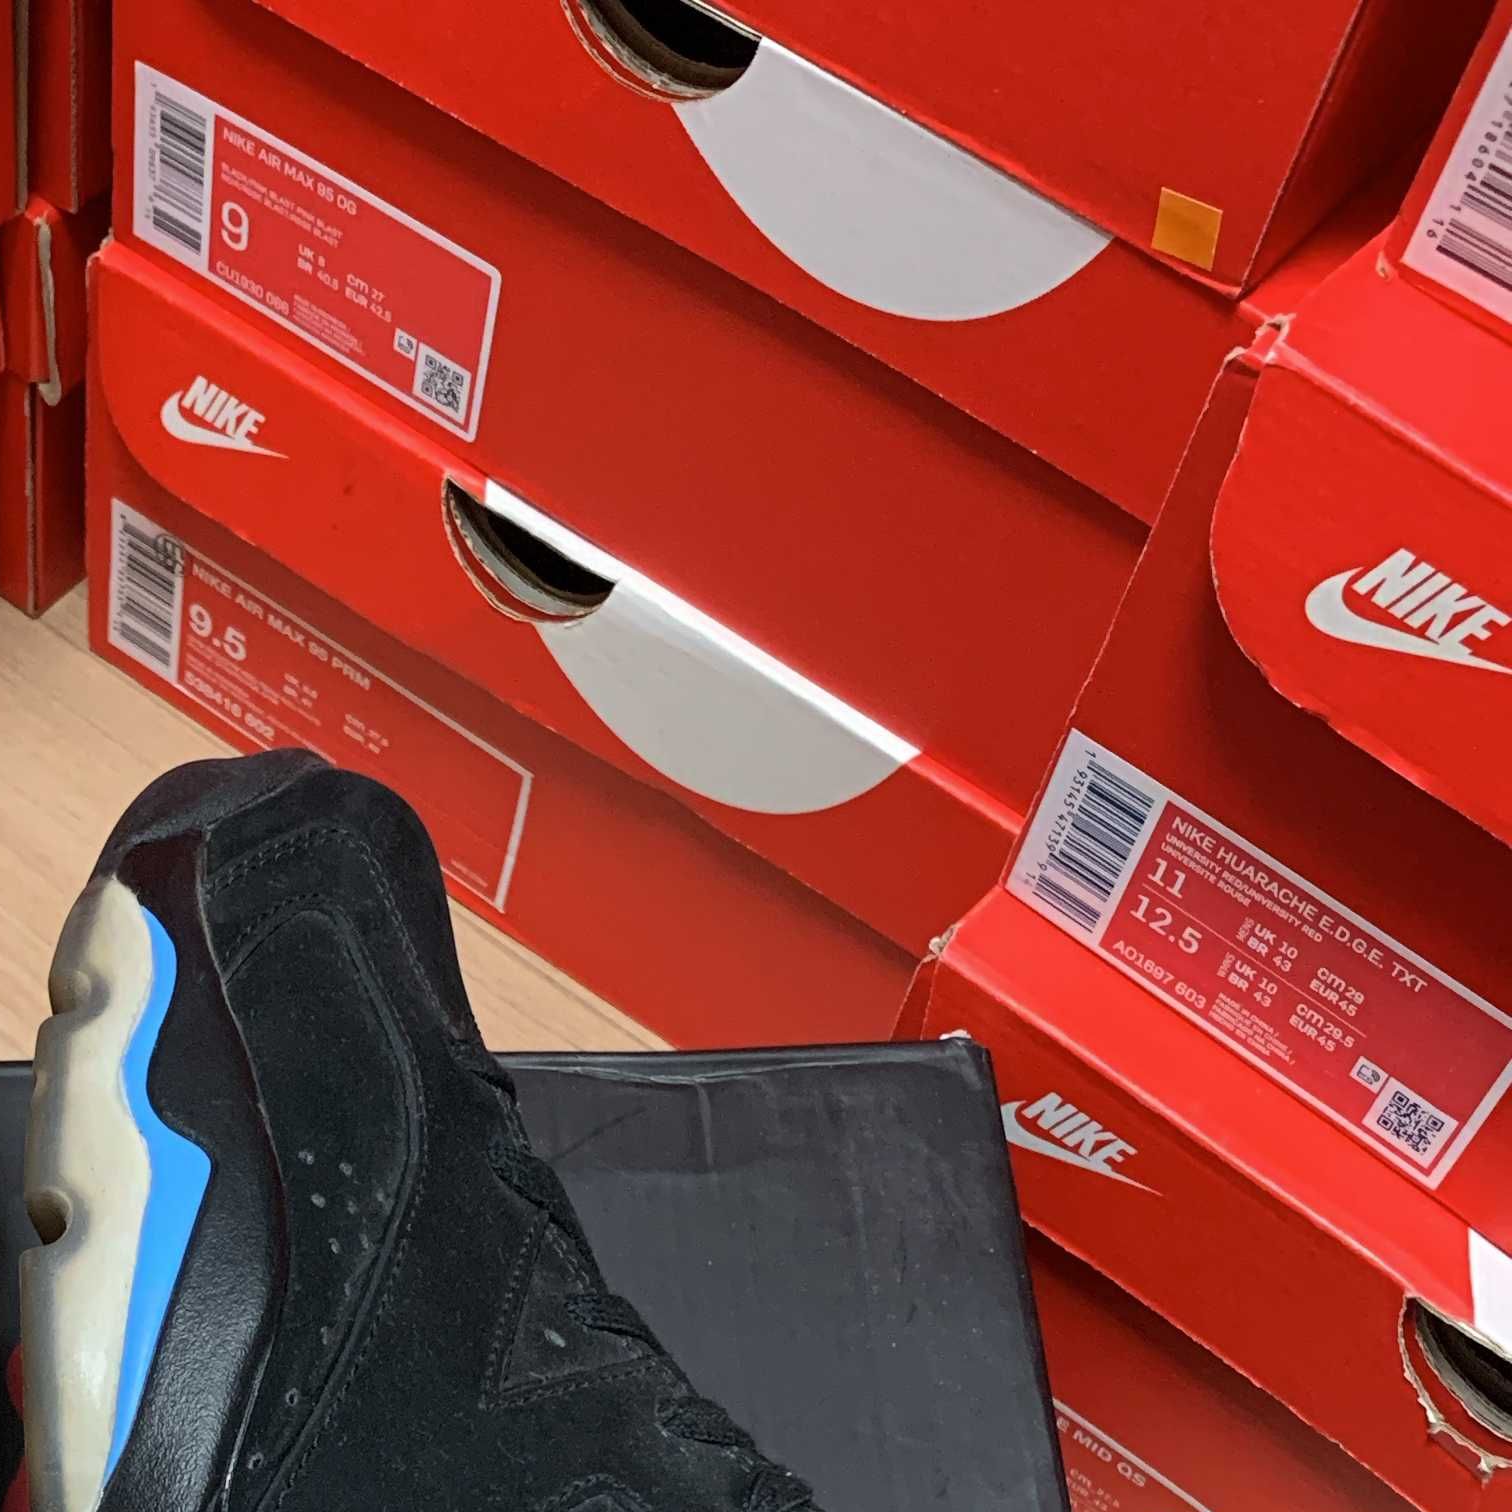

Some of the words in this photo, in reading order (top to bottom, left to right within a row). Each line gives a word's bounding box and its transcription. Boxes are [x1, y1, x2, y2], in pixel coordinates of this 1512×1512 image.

[224, 127, 255, 155] NIKE
[259, 149, 281, 171] AIR
[284, 162, 314, 190] MAX
[317, 182, 334, 202] 95
[337, 195, 356, 215] OG
[1464, 120, 1504, 182] 18604
[222, 202, 248, 251] 9
[299, 245, 314, 261] UK
[345, 287, 368, 308] EUR
[347, 274, 368, 293] cm
[372, 288, 385, 302] 27
[180, 374, 266, 439] NIKE
[1351, 547, 1512, 654] NIKE
[190, 604, 246, 660] 9.5
[193, 564, 231, 598] NIKE
[235, 594, 263, 619] AIR
[268, 614, 304, 646] MAX
[332, 656, 370, 690] PRM
[1064, 769, 1088, 810] 93145
[1046, 813, 1068, 852] 47139
[1148, 858, 1185, 898] 11
[1166, 833, 1221, 873] UNIVERSITY
[1222, 871, 1301, 926] RED/UNIVERSITY
[1301, 924, 1322, 942] RED
[1217, 880, 1251, 907] ROUGE
[1130, 895, 1202, 953] 12.5
[1172, 817, 1216, 853] NIKE
[1217, 847, 1318, 921] HUARACHE
[1319, 915, 1383, 968] E.D.G.E.
[1392, 962, 1427, 992] TXT
[1247, 936, 1268, 956] BR
[1273, 956, 1292, 972] 43
[1255, 924, 1276, 945] UK
[1279, 942, 1298, 959] 10
[1113, 941, 1174, 984] AO1697
[1175, 982, 1206, 1008] 603
[1228, 972, 1248, 991] BR
[1254, 992, 1271, 1007] 43
[1235, 960, 1256, 980] UK
[1258, 977, 1277, 994] 10
[1317, 968, 1346, 992] cm
[1345, 987, 1364, 1004] 29
[1310, 979, 1339, 1004] EUR
[1338, 1001, 1357, 1016] 45
[1289, 1015, 1318, 1040] EUR
[1317, 1036, 1336, 1051] 45
[1297, 1004, 1324, 1028] cm
[1323, 1022, 1355, 1047] 29.5
[1024, 1091, 1138, 1171] NIKE
[1073, 1430, 1112, 1462] MID
[1117, 1461, 1147, 1487] QS
